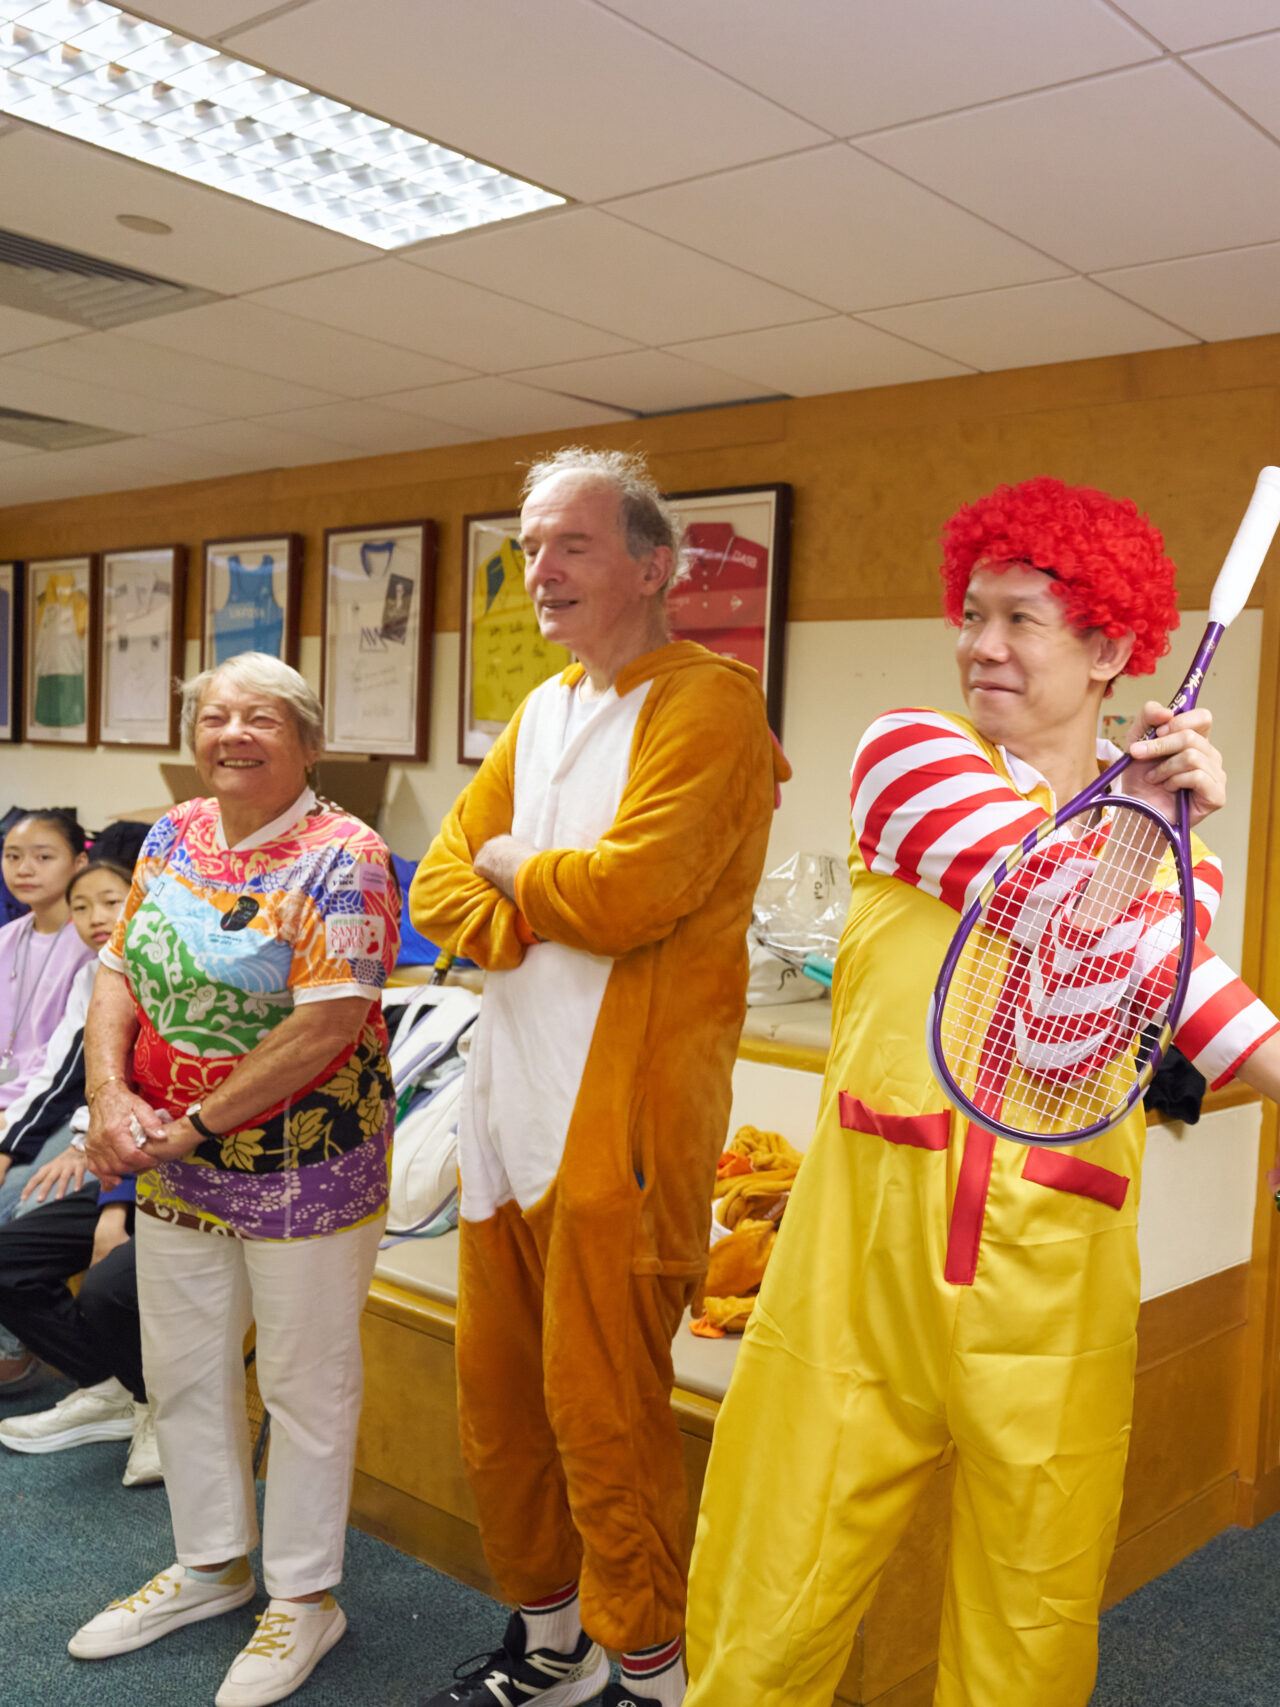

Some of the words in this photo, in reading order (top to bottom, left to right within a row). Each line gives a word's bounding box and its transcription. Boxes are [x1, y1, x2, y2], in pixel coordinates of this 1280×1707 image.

[1184, 667, 1203, 695] HK
[331, 926, 364, 936] SANTA
[331, 937, 364, 948] CLAUS
